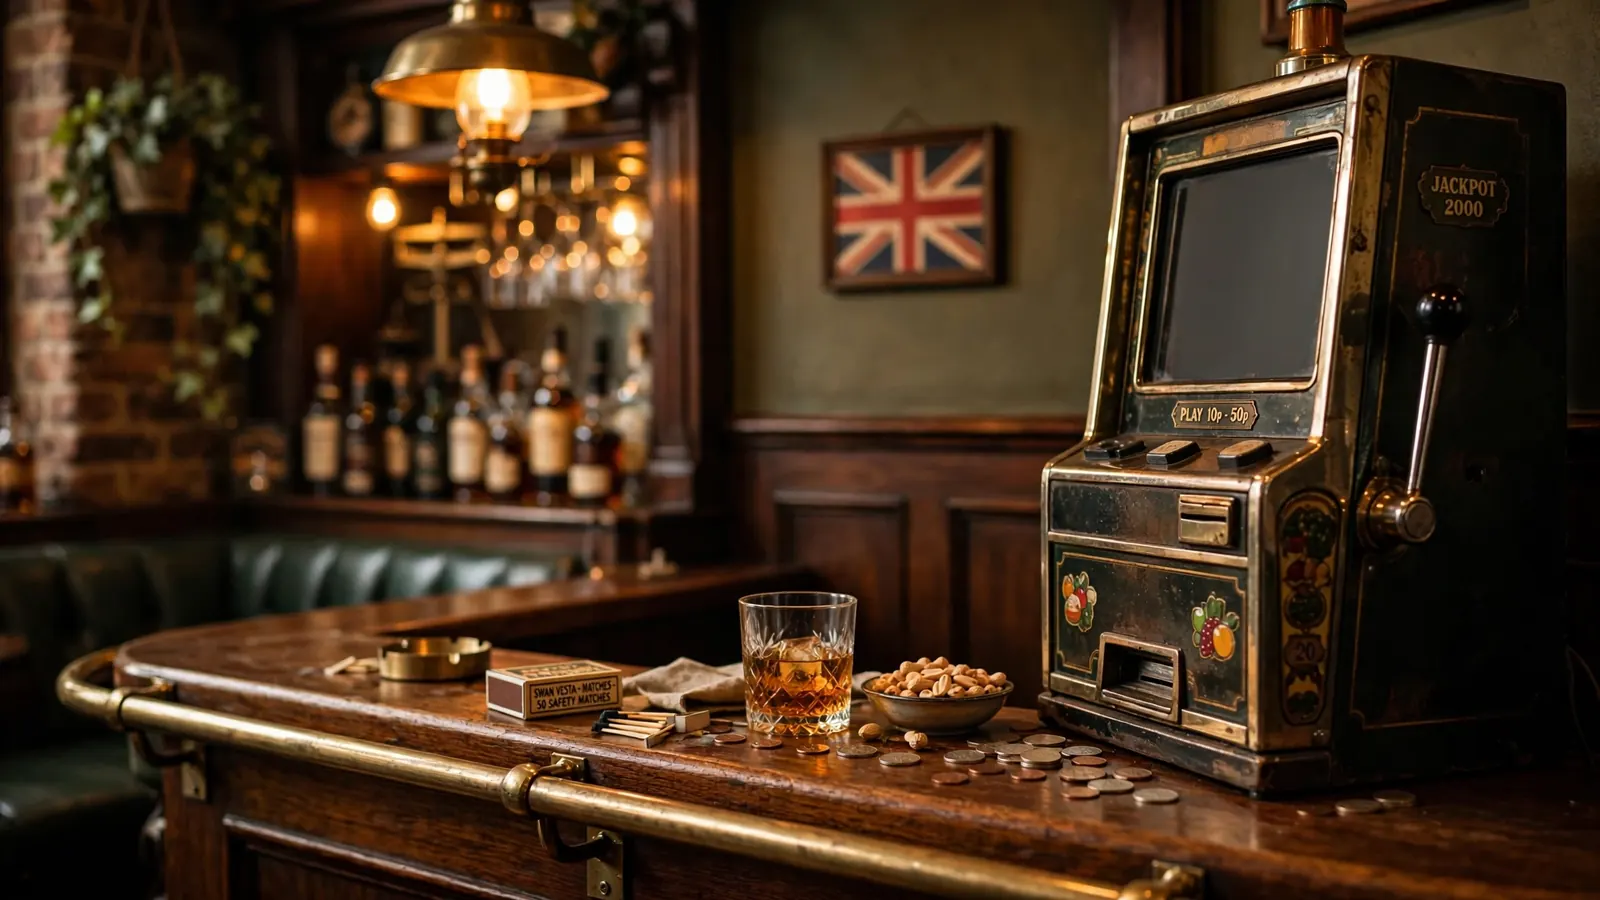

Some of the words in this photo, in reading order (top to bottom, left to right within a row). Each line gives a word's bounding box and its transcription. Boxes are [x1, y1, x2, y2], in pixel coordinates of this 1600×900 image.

[1431, 176, 1497, 197] JACKPOT
[1444, 199, 1483, 217] 2000
[1180, 407, 1203, 422] PLAY
[1207, 407, 1222, 423] 10p
[1230, 407, 1249, 424] 50p
[1296, 642, 1315, 661] 20
[534, 687, 554, 698] SWAN
[556, 684, 577, 696] VESTA
[582, 680, 612, 692] MATCHES
[536, 699, 546, 710] 50
[548, 696, 575, 708] SAFETY
[578, 692, 611, 704] MATCHES
